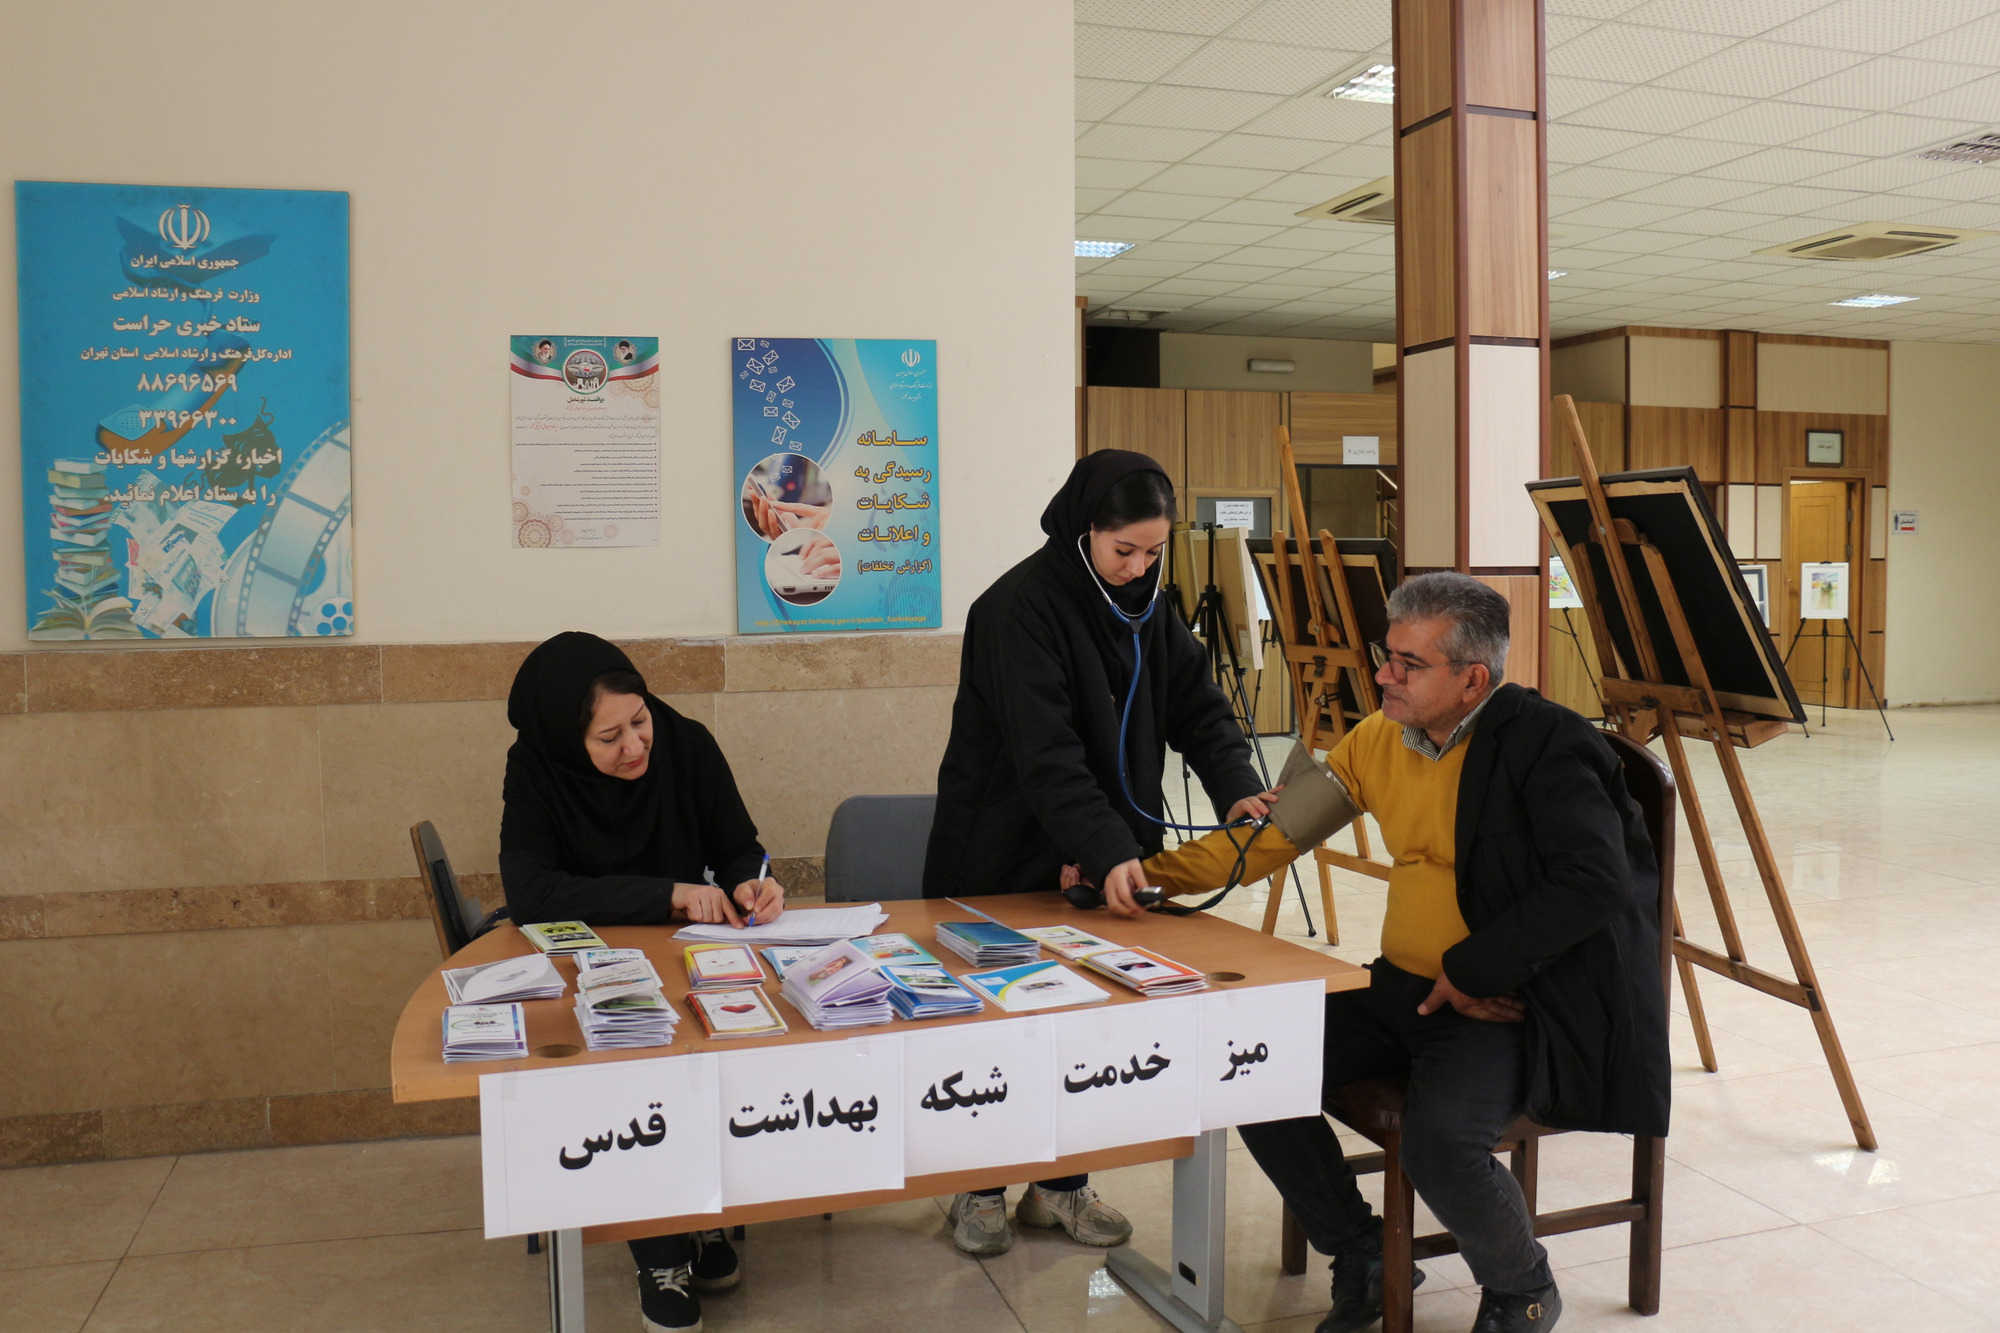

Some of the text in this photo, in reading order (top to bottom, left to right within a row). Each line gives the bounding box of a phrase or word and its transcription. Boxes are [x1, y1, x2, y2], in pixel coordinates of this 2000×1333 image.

[130, 254, 240, 270] جمهوری اسلامی ایران
[112, 286, 260, 303] وزارت فرهنگ و ارشاد اسلامی
[113, 314, 261, 337] ستاد خبری حراست
[80, 346, 110, 361] تهران
[110, 347, 139, 361] استان
[143, 347, 179, 361] اسلامی
[181, 348, 209, 362] ارشاد
[211, 352, 217, 362] و
[218, 347, 252, 362] فرهنگ
[137, 372, 238, 392] ۸۸۶۹۶۵۶۹
[138, 410, 238, 429] ۳۳۹۶۶۳۰۰
[857, 430, 928, 446] سامانه
[94, 448, 282, 470] اخبار، گزارشها و شکایات
[854, 461, 932, 484] رسیدگی به
[103, 483, 276, 506] را به ستاد اعلام نمائید.
[856, 492, 930, 513] شکایات
[857, 525, 931, 546] و اعلانات
[857, 559, 932, 574] (گزارش تخلفات)
[558, 1039, 1269, 1170] میز خدمت شبکه بهداشت قدس
